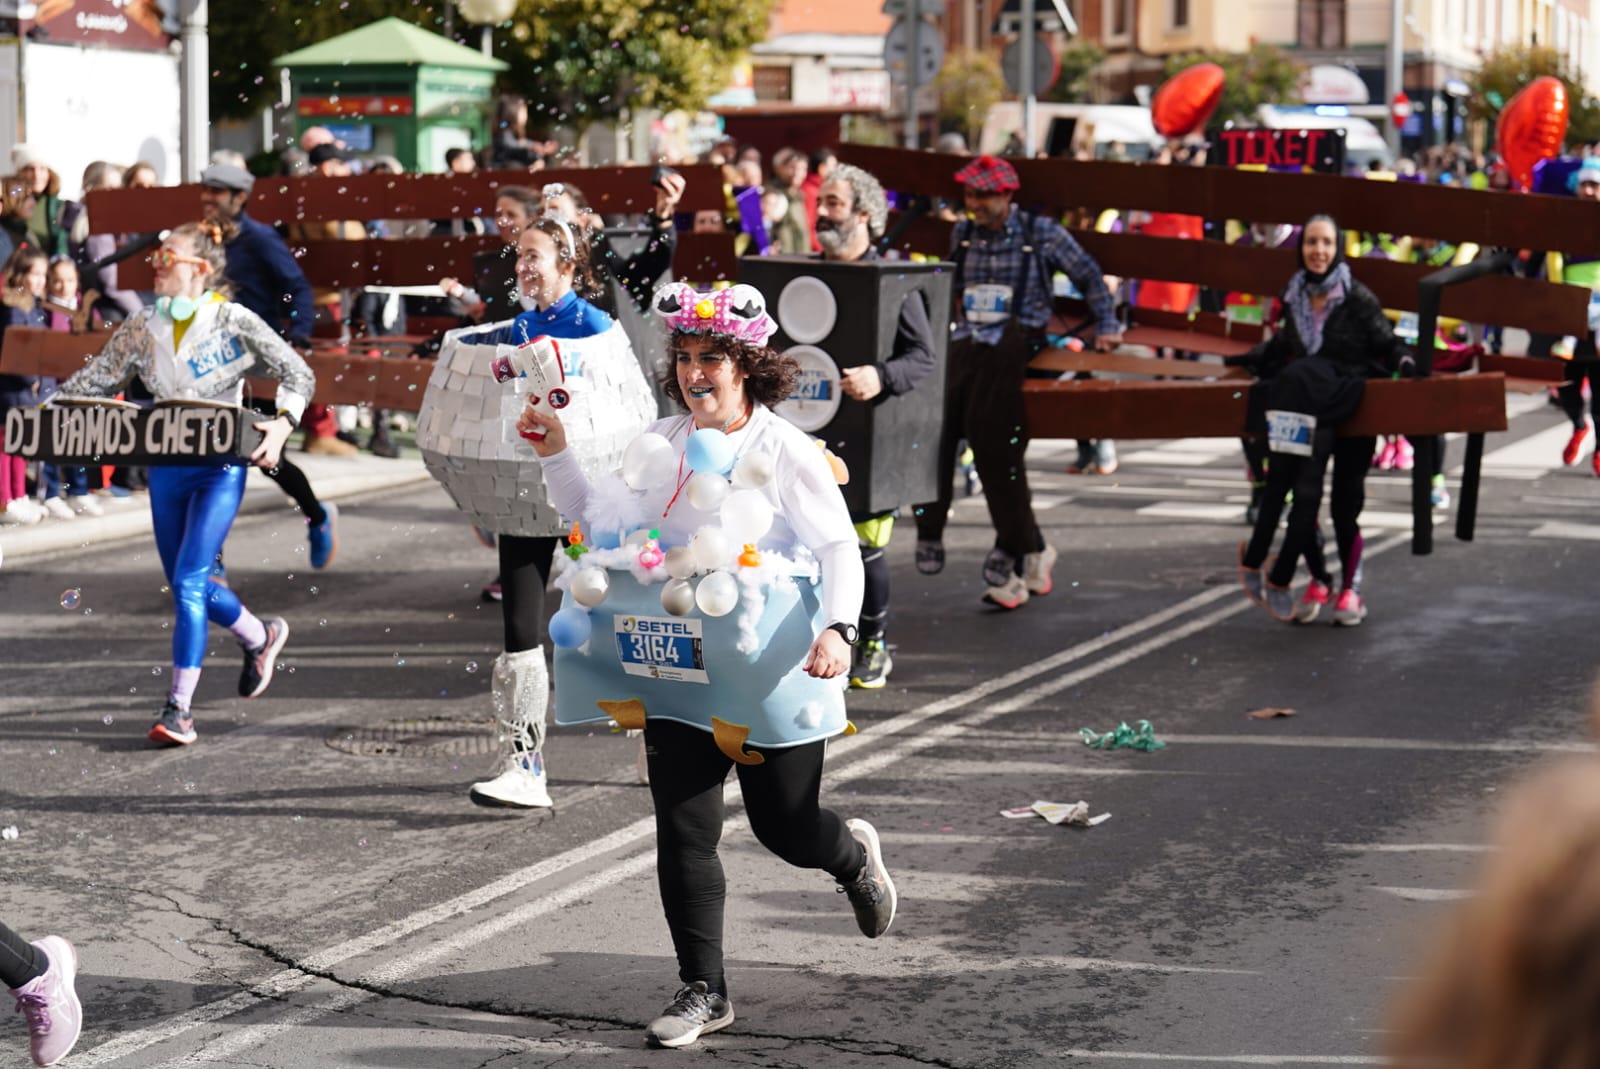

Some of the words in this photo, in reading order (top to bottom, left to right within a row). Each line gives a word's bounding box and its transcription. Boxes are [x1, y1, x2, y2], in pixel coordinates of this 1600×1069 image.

[1220, 130, 1326, 168] TICKET
[5, 409, 41, 455] DJ
[53, 407, 138, 456] VAMOS
[145, 407, 234, 456] CHETO
[637, 620, 693, 635] SETEL
[630, 634, 679, 663] 3164
